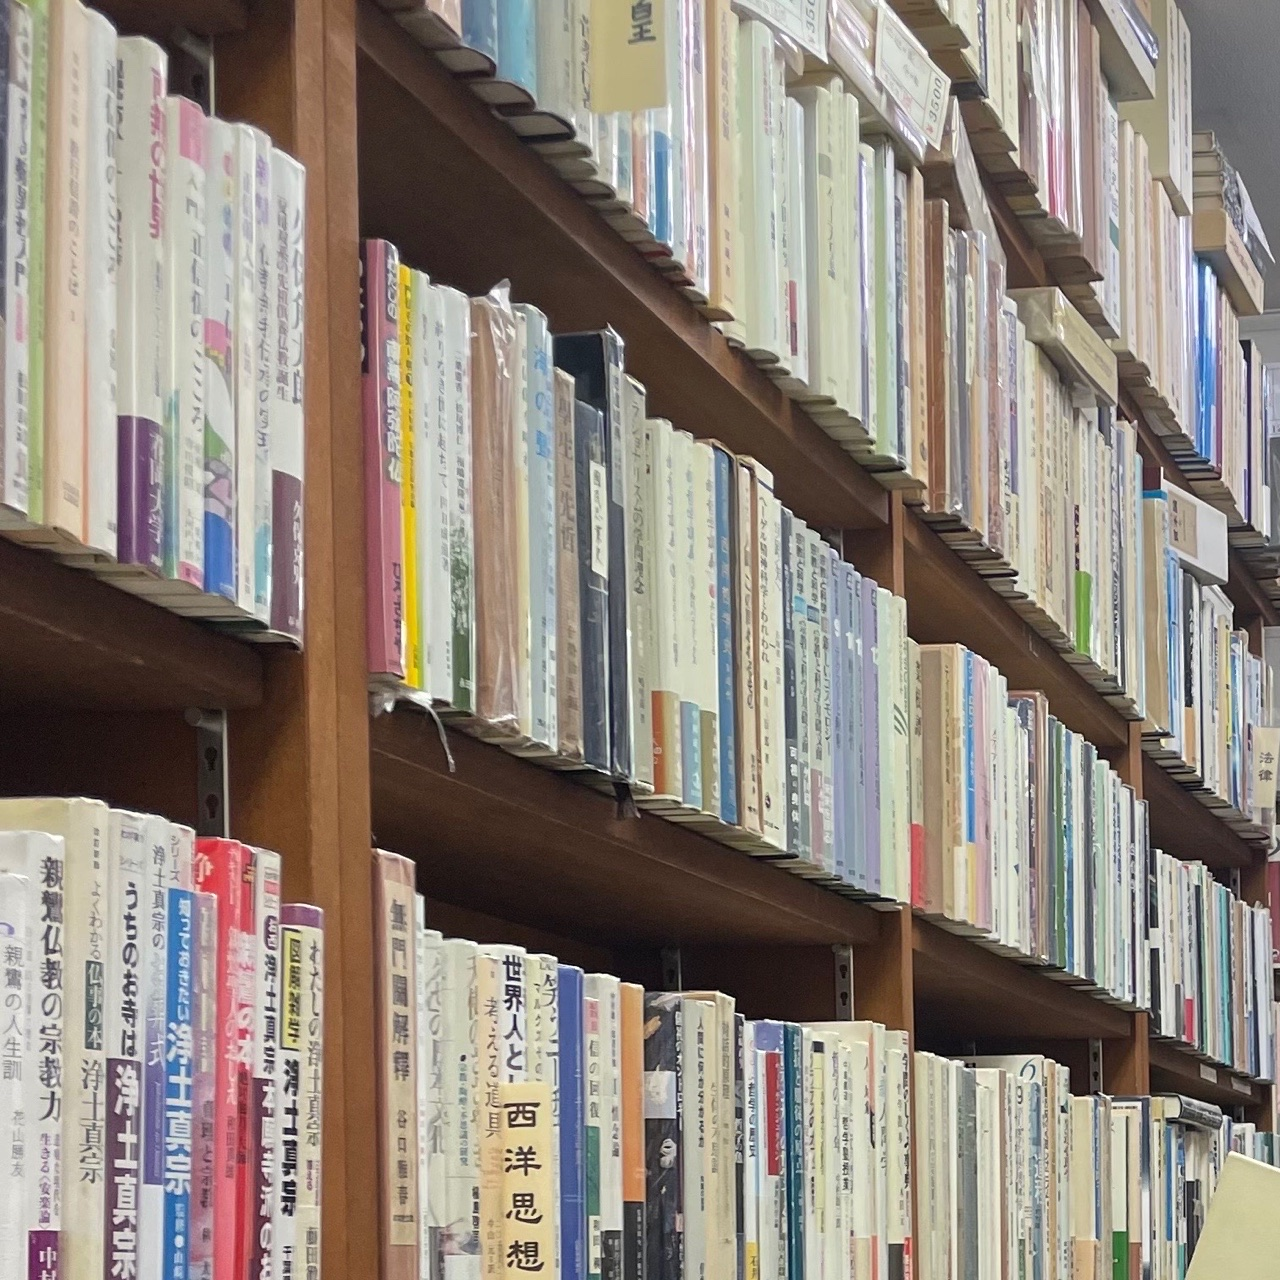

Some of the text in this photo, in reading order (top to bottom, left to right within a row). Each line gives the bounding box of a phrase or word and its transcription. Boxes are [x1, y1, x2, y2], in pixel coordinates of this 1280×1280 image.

[1257, 751, 1276, 782] 法律
[2, 944, 24, 1082] 親鸞の人生訓
[38, 856, 64, 1122] 親鸞仏教の宗教力
[86, 963, 103, 1049] 仏事の本
[121, 881, 140, 1057] うちのお寺は
[502, 955, 526, 1084] 世界人と
[80, 1057, 104, 1184] 浄土真宗
[167, 1022, 192, 1196] 浄土真宗
[282, 1057, 301, 1218] 浄土真宗
[483, 996, 501, 1139] 考える道具
[588, 1039, 600, 1118] 信の回復
[11, 1109, 25, 1178] 花山勝友
[110, 1064, 140, 1280] 浄土真宗
[502, 1101, 545, 1273] 西洋思想
